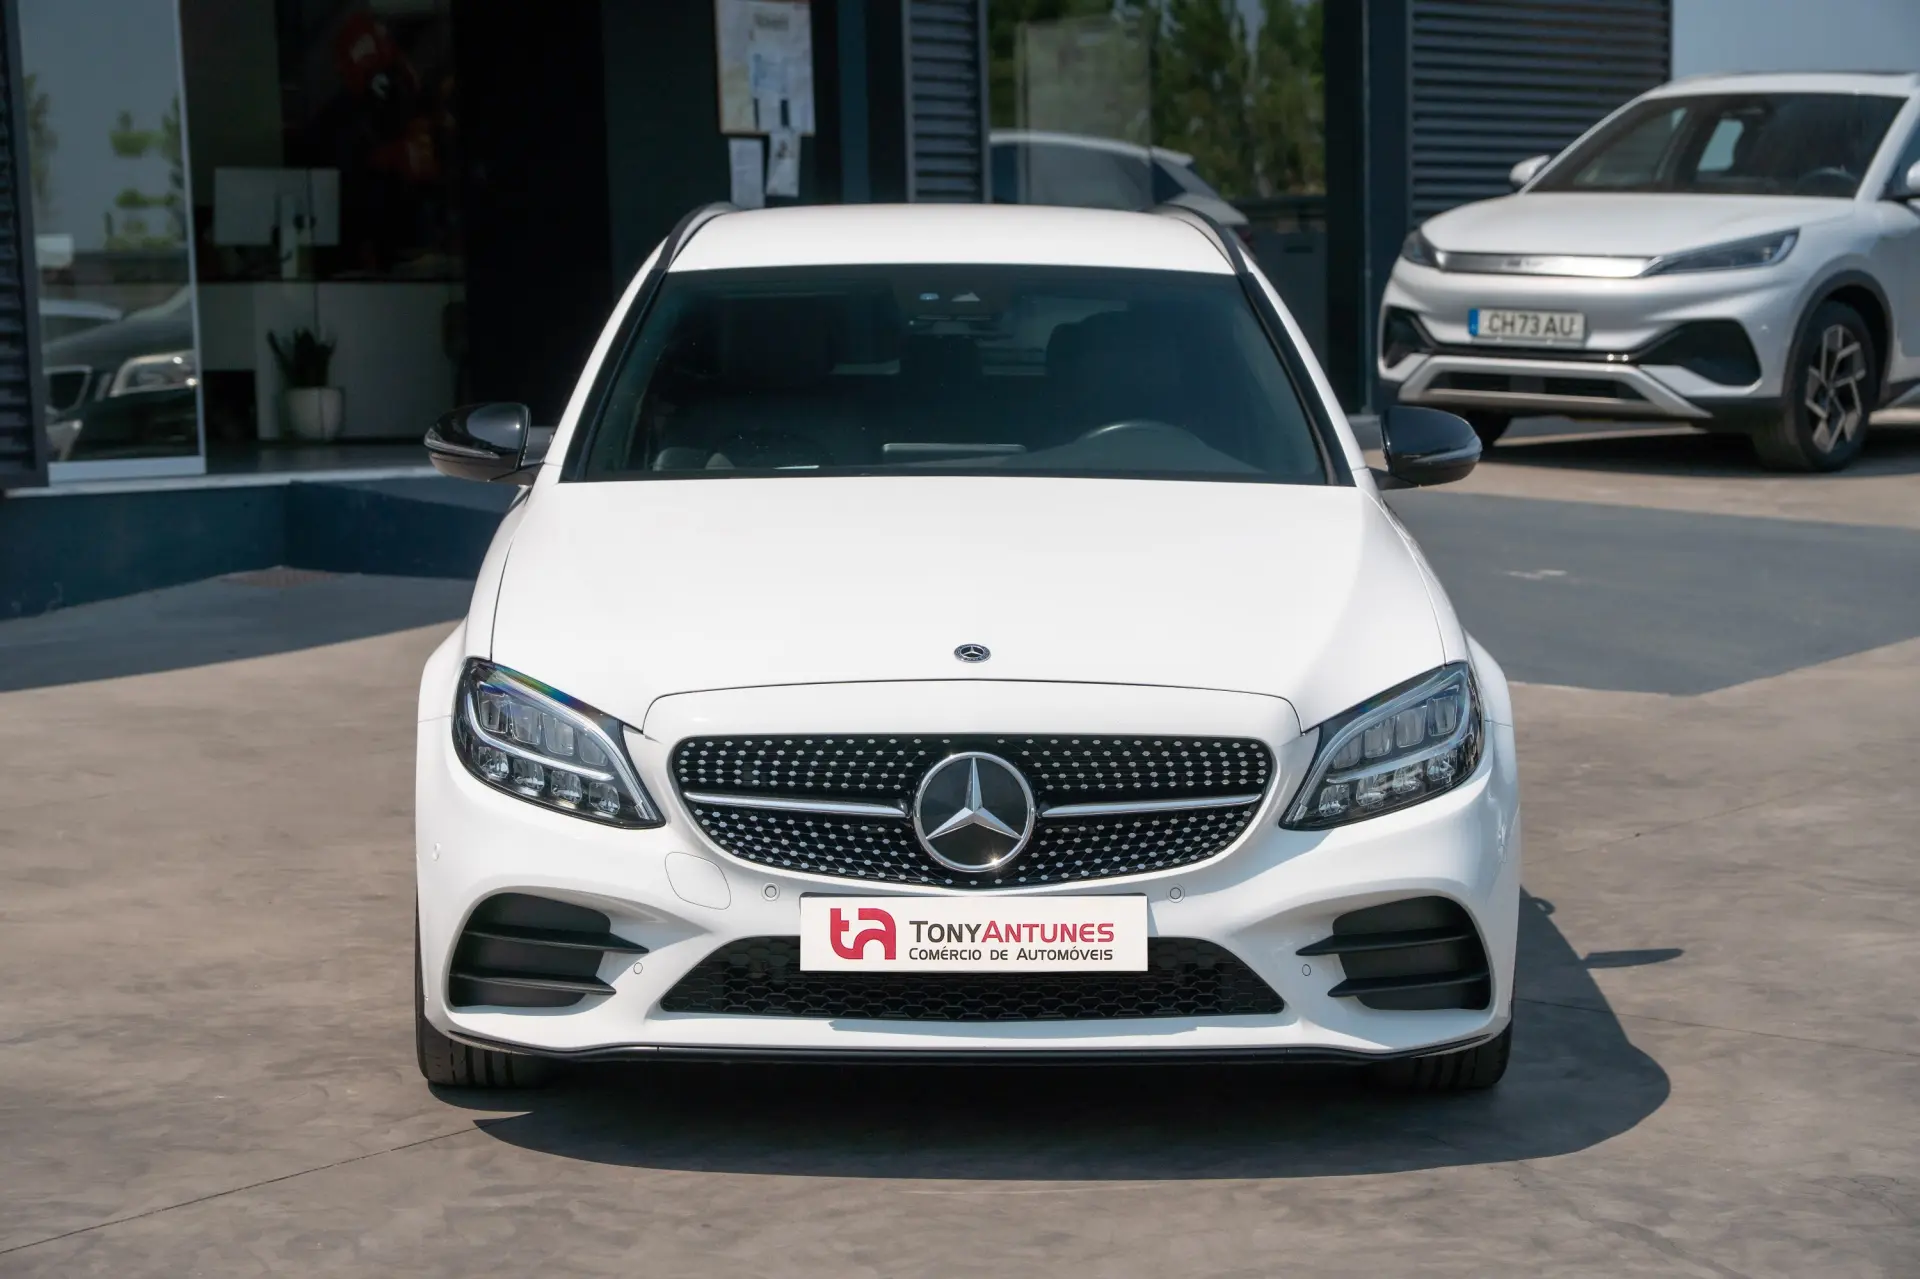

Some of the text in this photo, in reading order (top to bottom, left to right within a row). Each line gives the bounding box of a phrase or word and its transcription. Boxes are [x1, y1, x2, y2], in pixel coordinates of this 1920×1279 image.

[909, 946, 1113, 961] COMÉRCIO DE AUTOMÓVEIS
